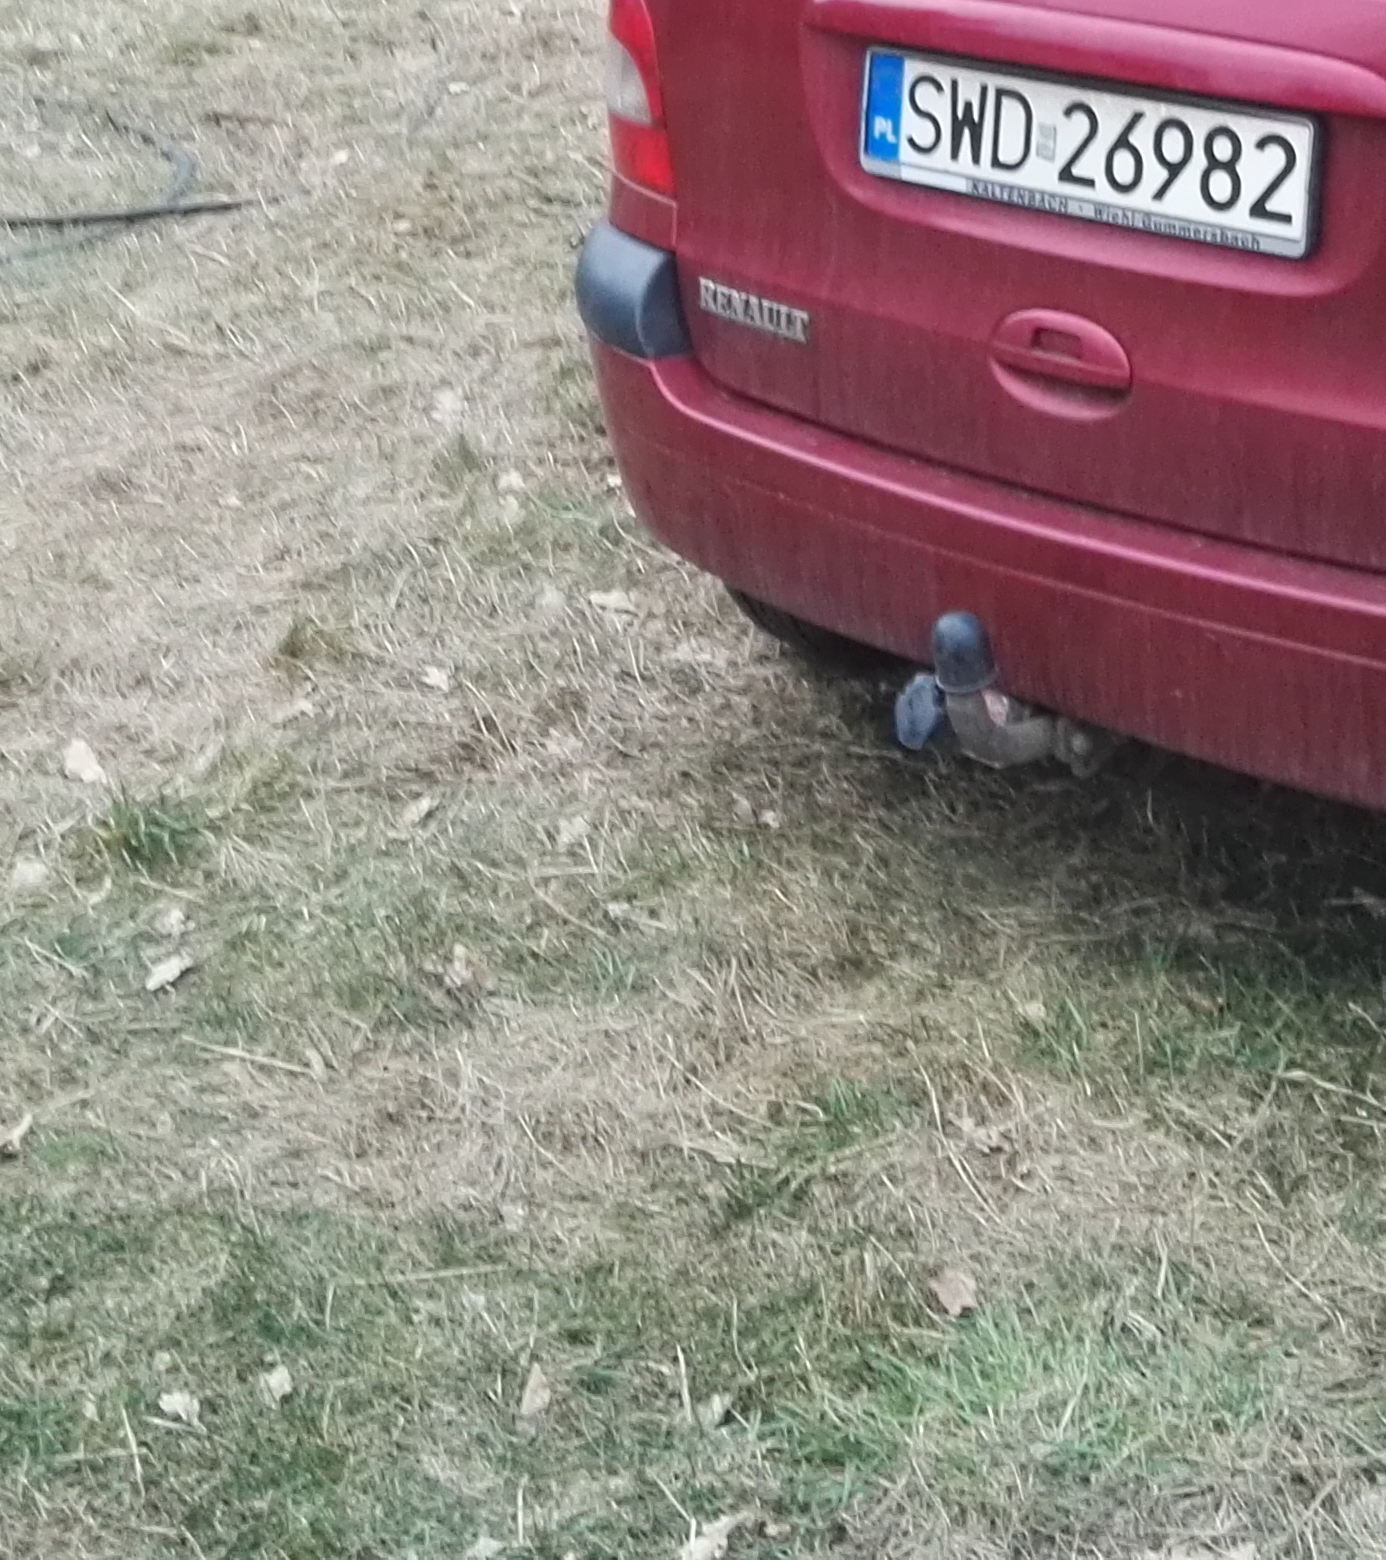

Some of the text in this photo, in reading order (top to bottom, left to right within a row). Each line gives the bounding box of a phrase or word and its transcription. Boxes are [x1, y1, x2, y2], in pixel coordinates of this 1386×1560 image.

[873, 115, 898, 144] PL
[905, 73, 1298, 226] SWD 26982
[697, 275, 811, 345] RENAULT
